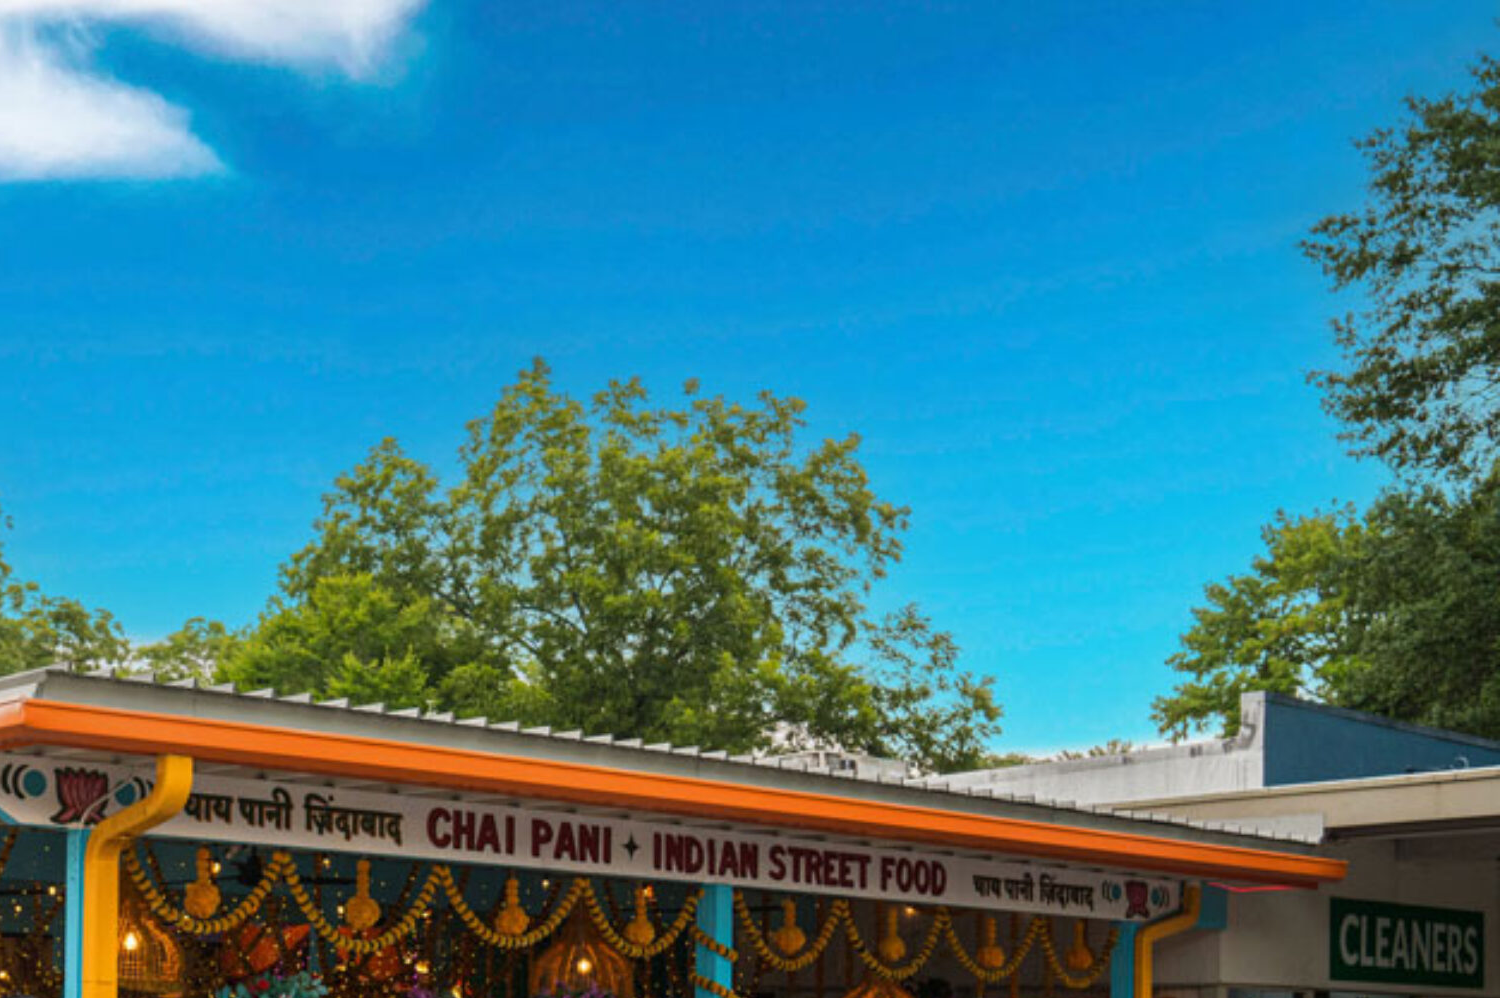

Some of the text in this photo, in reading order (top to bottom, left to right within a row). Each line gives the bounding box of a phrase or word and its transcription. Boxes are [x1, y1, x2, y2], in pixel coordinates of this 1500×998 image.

[237, 787, 294, 831] पानी
[427, 807, 947, 897] CHAI PANI INDIAN STREET FOOD
[1339, 913, 1478, 974] CLEANERS
